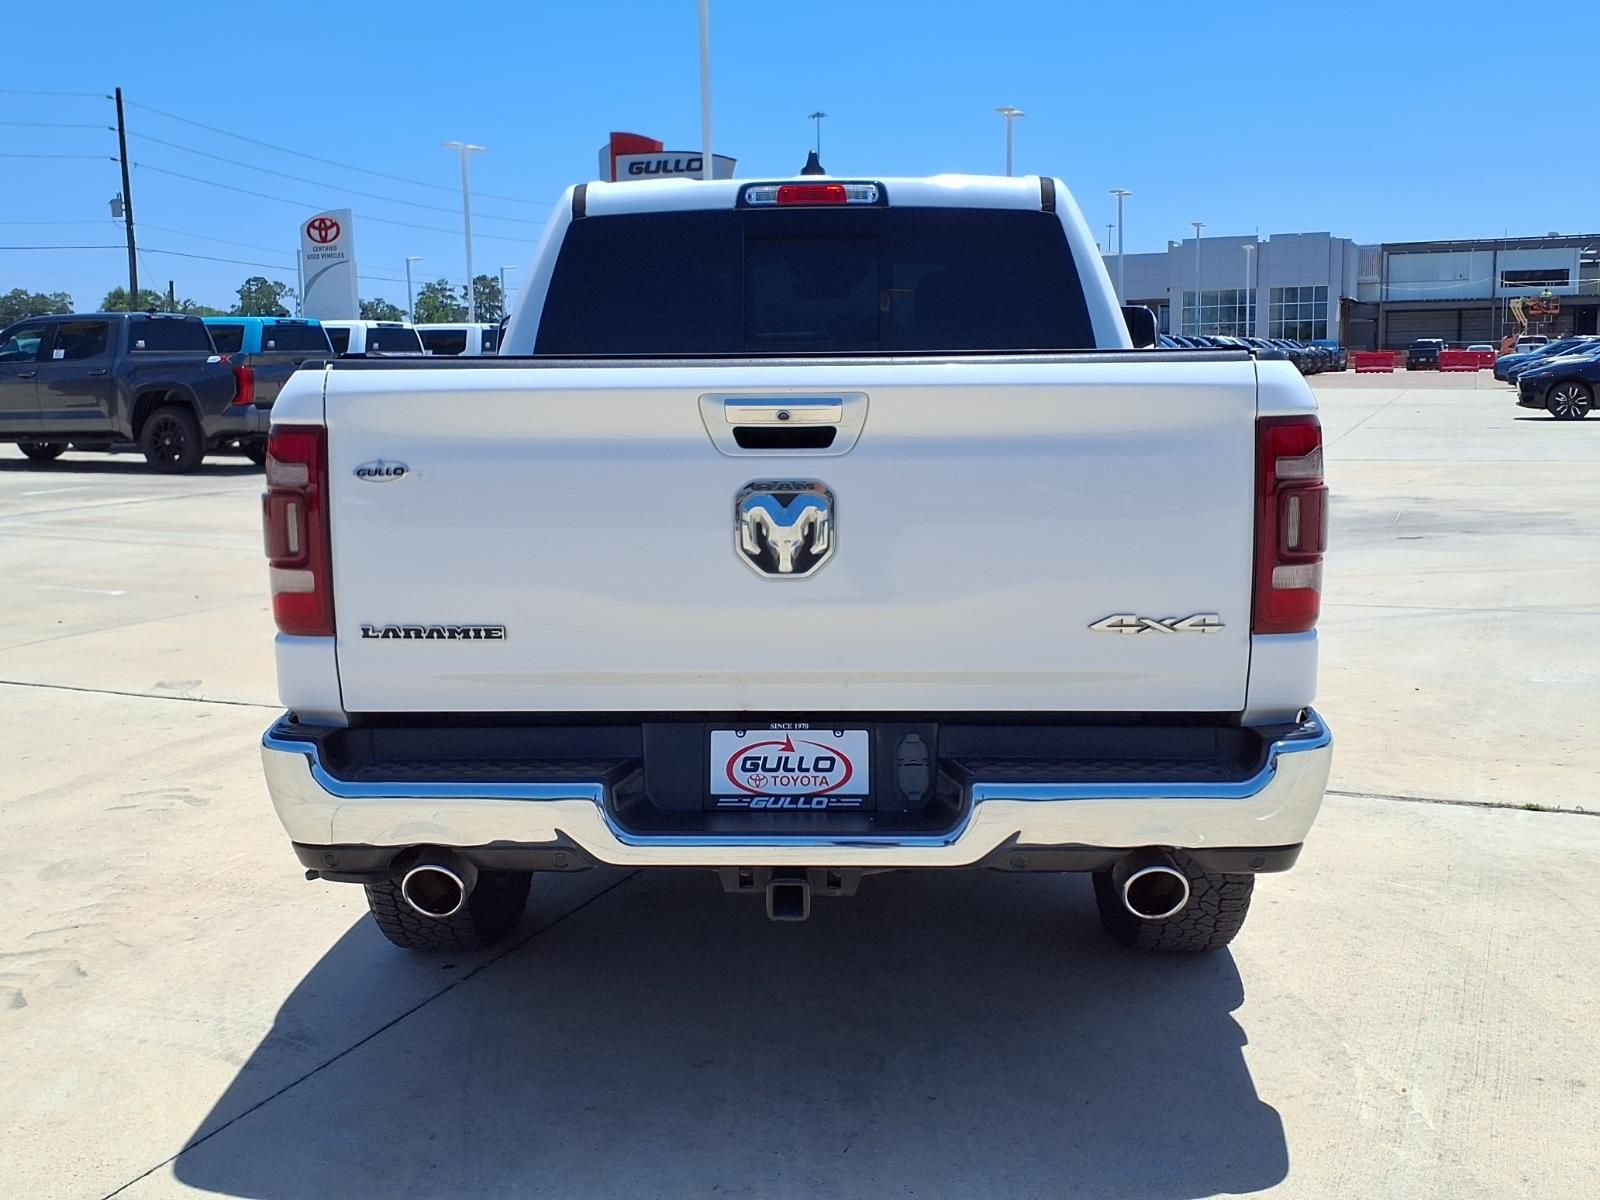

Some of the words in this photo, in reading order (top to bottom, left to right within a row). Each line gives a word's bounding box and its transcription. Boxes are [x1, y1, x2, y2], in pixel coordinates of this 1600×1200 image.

[628, 158, 703, 175] GULLO
[356, 467, 405, 477] GULLO
[360, 624, 506, 640] LARAMIE
[769, 722, 793, 730] SINCE
[794, 722, 810, 730] 1970
[740, 756, 837, 773] GULLO
[771, 775, 830, 787] TOYOTA
[749, 796, 829, 809] GULLO
